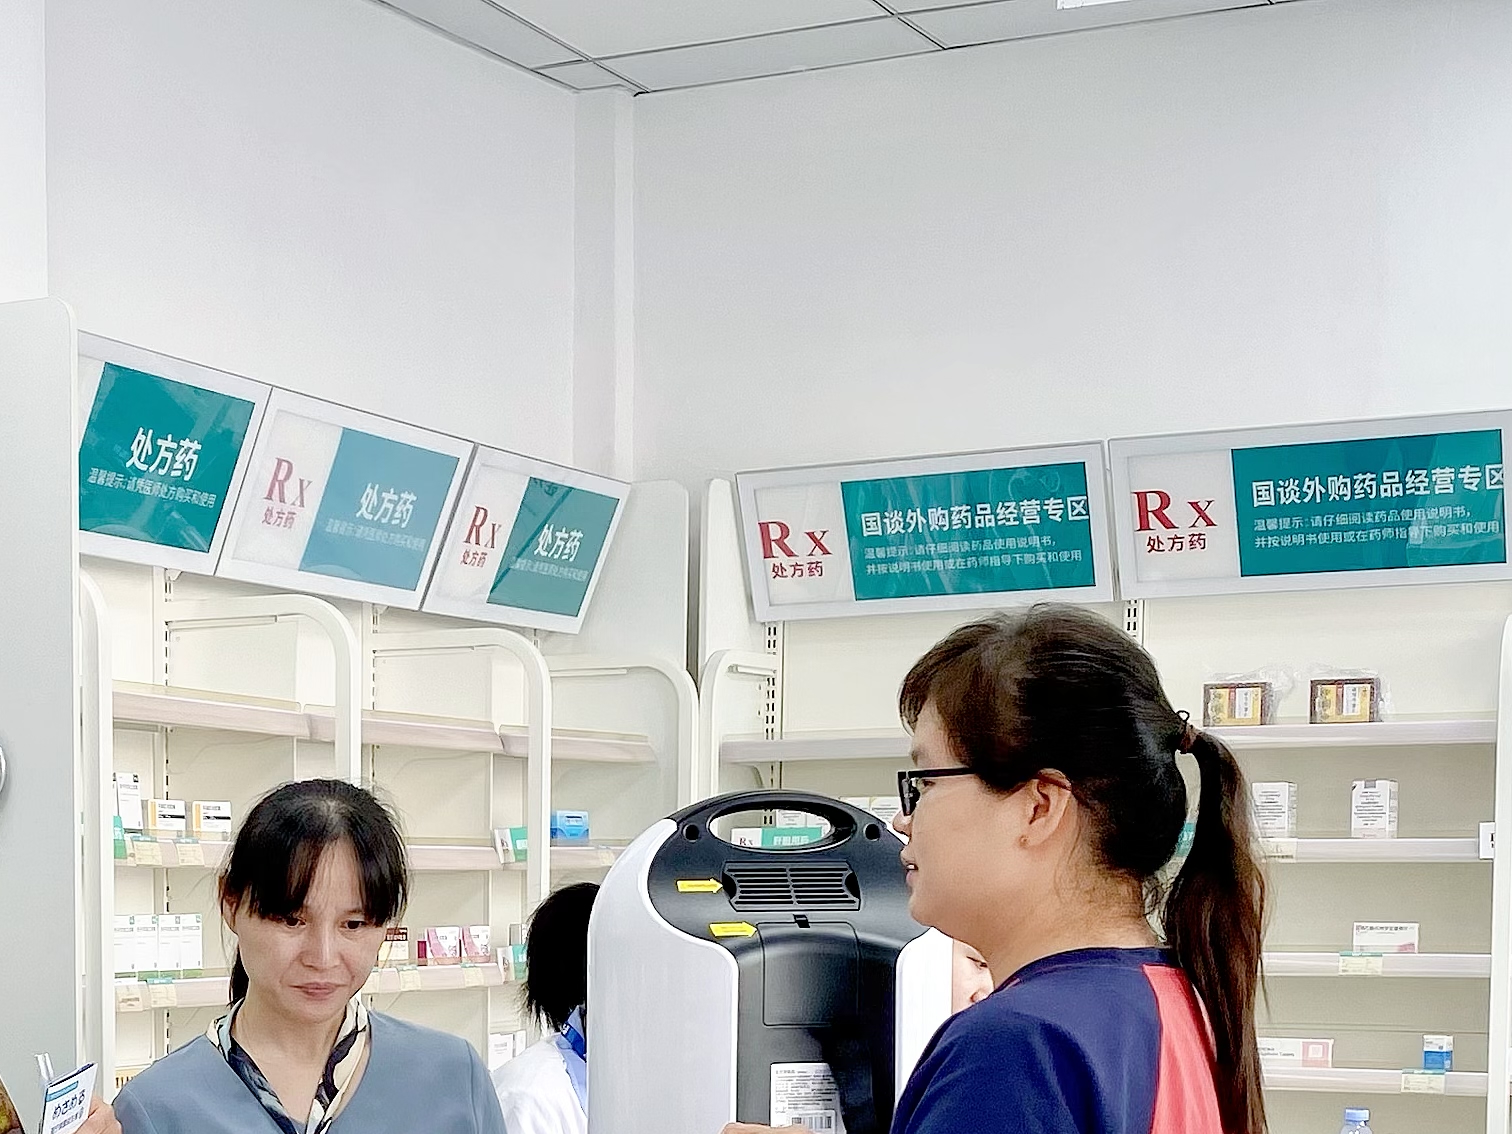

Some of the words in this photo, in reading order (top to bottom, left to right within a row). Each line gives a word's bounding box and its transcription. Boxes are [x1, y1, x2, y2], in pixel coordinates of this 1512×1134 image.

[125, 427, 202, 482] 处方药
[263, 457, 313, 508] Rx
[1252, 463, 1505, 508] 国谈外购药品经营专区
[261, 506, 299, 530] 处方药
[356, 482, 418, 529] 处方药
[860, 496, 1090, 537] 国谈外购药品经营专区
[1131, 489, 1218, 532] Rx
[463, 505, 502, 549] Rx
[534, 523, 583, 562] 处方药
[758, 520, 833, 559] Rx
[1147, 532, 1207, 553] 处方药
[460, 549, 488, 568] 处方药
[771, 560, 824, 579] 处方药
